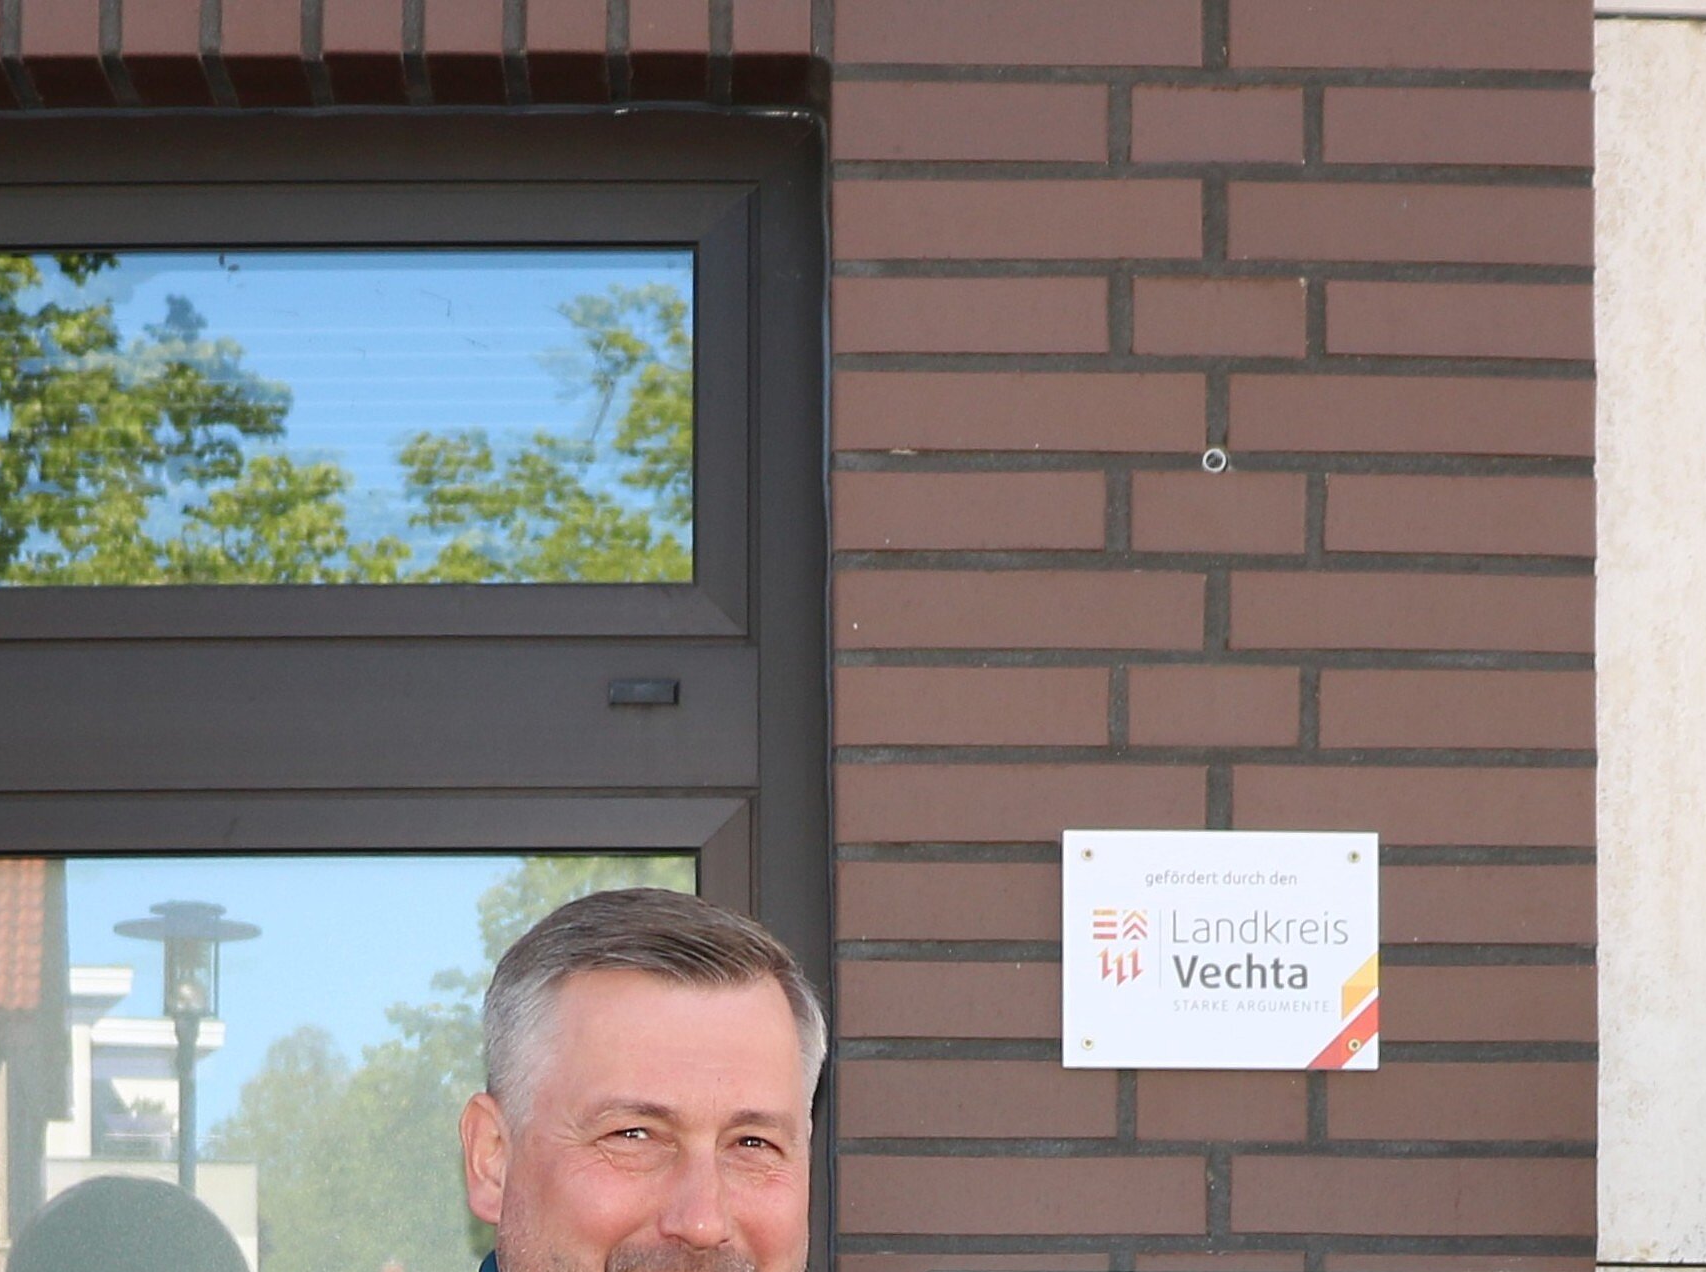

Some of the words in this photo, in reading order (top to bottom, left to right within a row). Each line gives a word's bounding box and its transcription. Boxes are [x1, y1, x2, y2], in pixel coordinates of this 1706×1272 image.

[1145, 870, 1219, 888] gefördert
[1222, 870, 1265, 886] durch
[1269, 871, 1298, 886] den
[1172, 909, 1349, 946] Landkreis
[1172, 953, 1309, 990] Vechta
[1173, 999, 1229, 1012] STARKE
